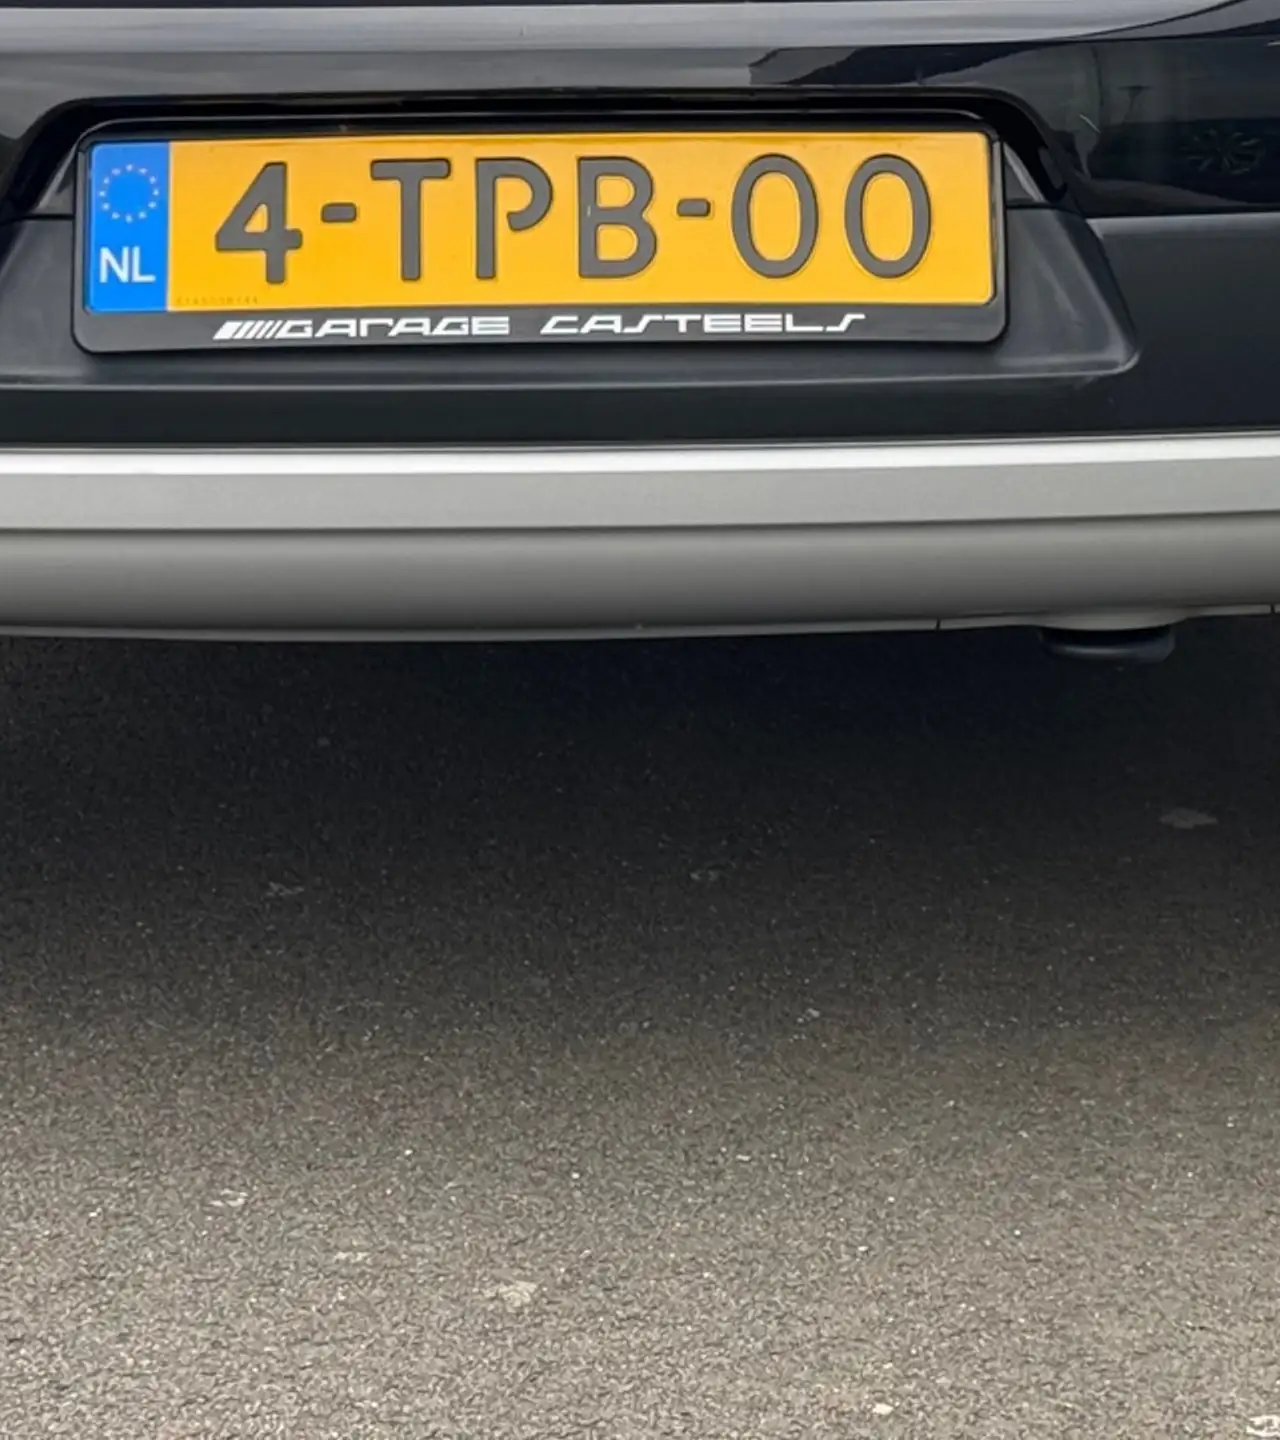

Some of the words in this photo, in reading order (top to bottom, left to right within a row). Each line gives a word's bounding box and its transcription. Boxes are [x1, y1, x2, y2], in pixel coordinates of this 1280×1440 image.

[214, 152, 934, 285] 4-TPB-00
[99, 247, 156, 284] NL
[540, 312, 866, 335] CASTEELS
